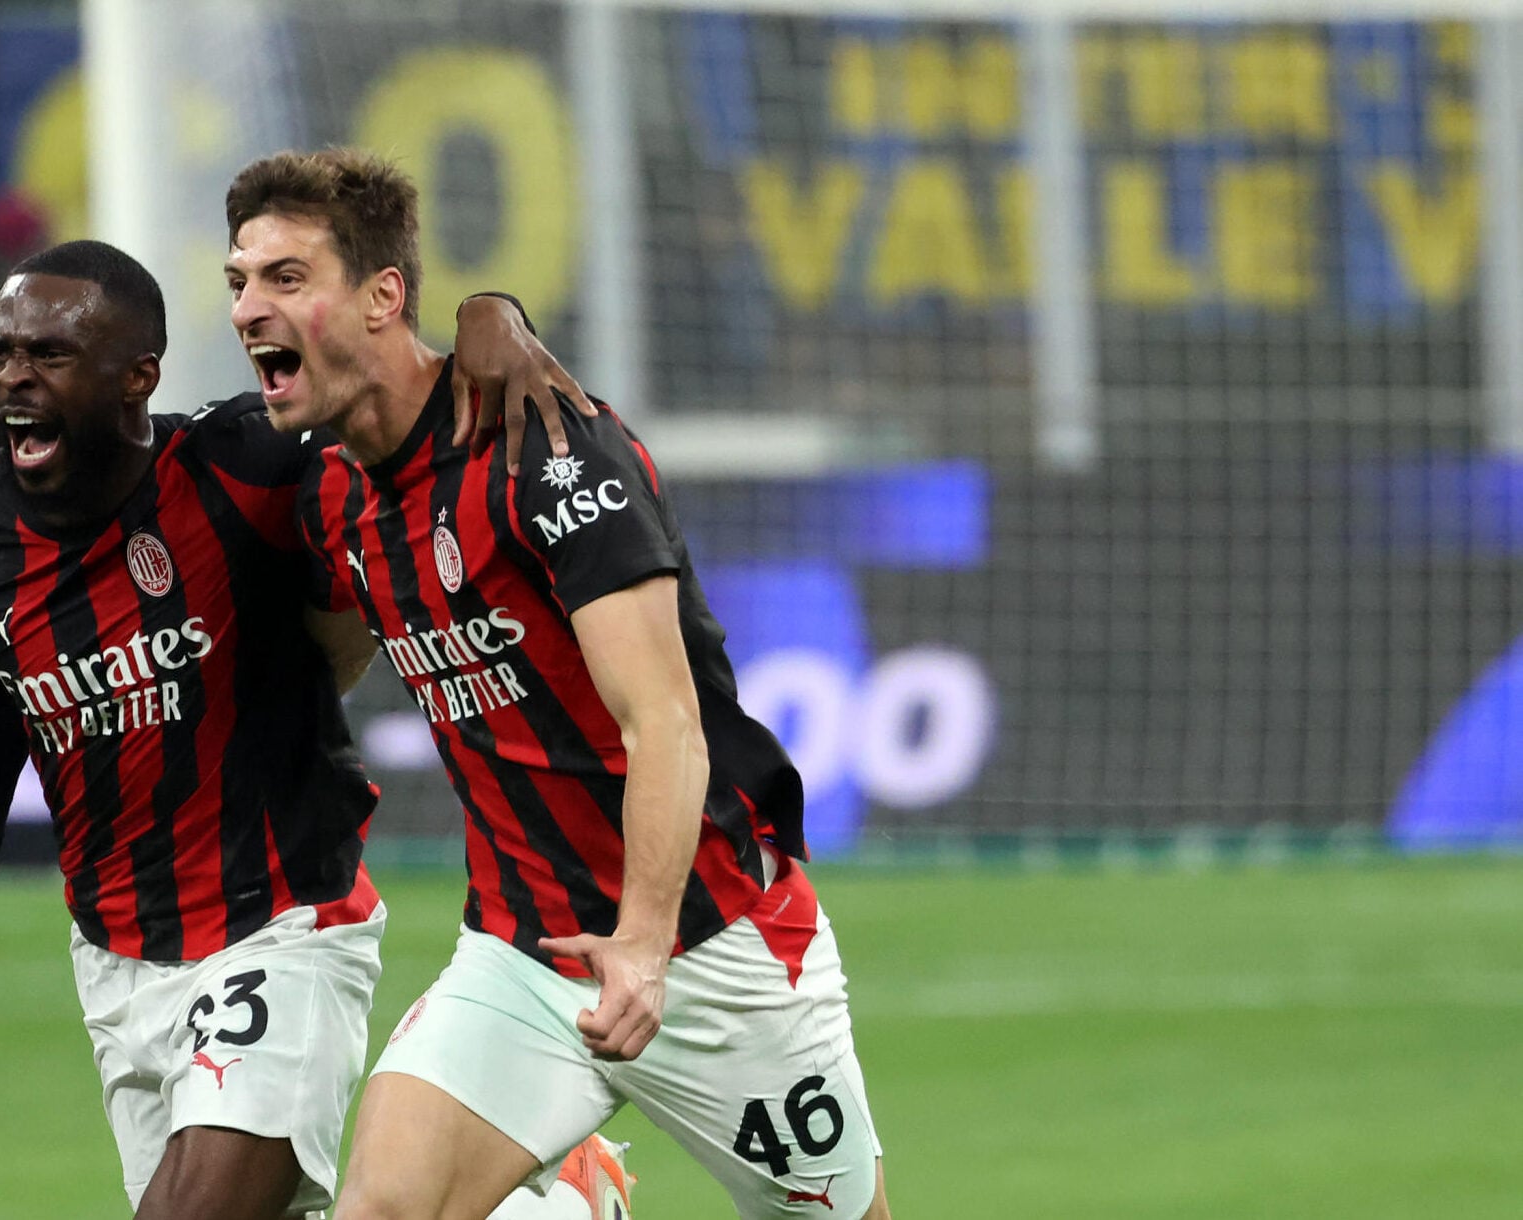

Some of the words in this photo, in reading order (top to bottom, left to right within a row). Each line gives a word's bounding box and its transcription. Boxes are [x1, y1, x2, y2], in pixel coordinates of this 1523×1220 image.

[532, 478, 629, 546] MSC
[370, 606, 525, 678] mirates
[79, 680, 182, 737] BETTER
[440, 661, 529, 722] BETTER
[733, 1074, 844, 1178] 46
